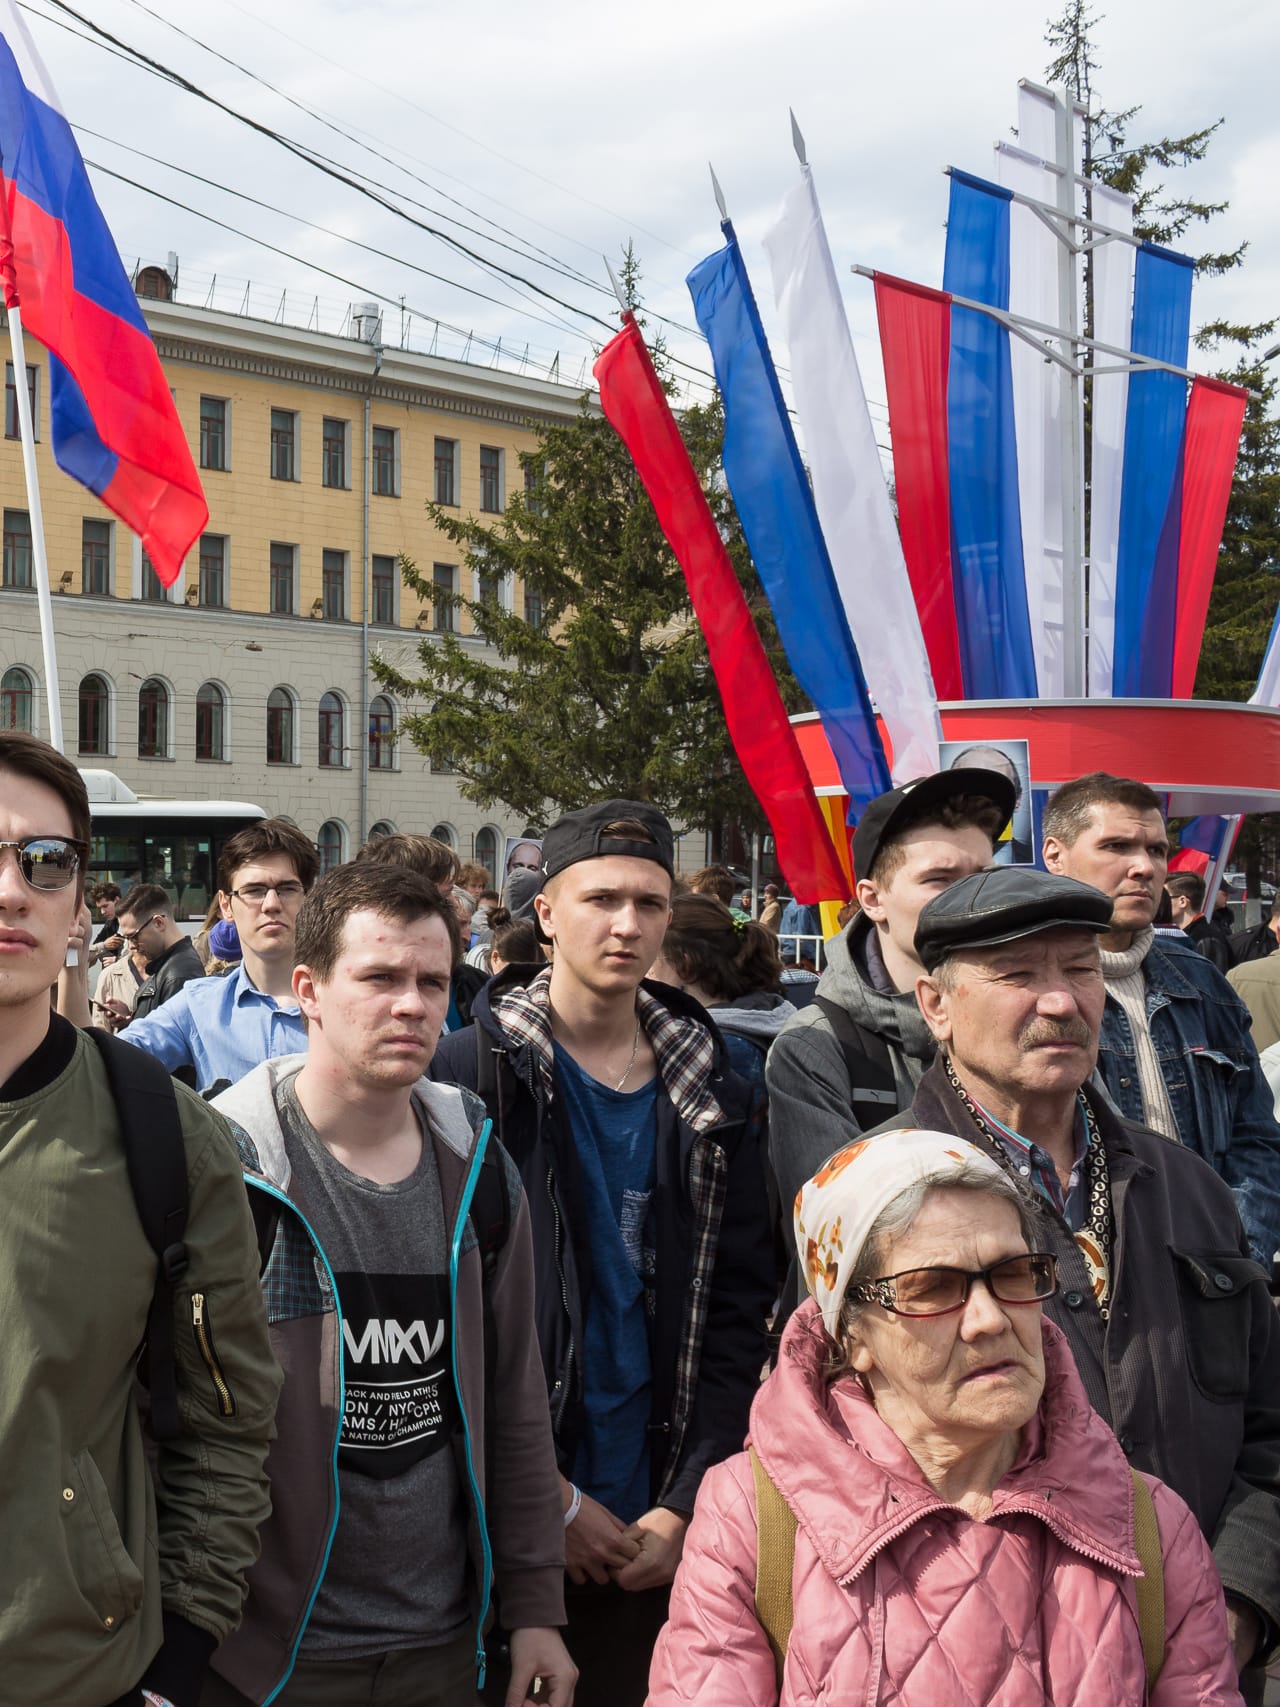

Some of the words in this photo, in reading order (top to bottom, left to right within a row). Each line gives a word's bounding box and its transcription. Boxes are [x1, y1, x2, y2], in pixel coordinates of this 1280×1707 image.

[344, 1389, 367, 1399] ACK
[369, 1391, 390, 1401] AND
[345, 1400, 369, 1415] DN
[413, 1399, 441, 1418] CPH
[348, 1430, 385, 1441] NATION
